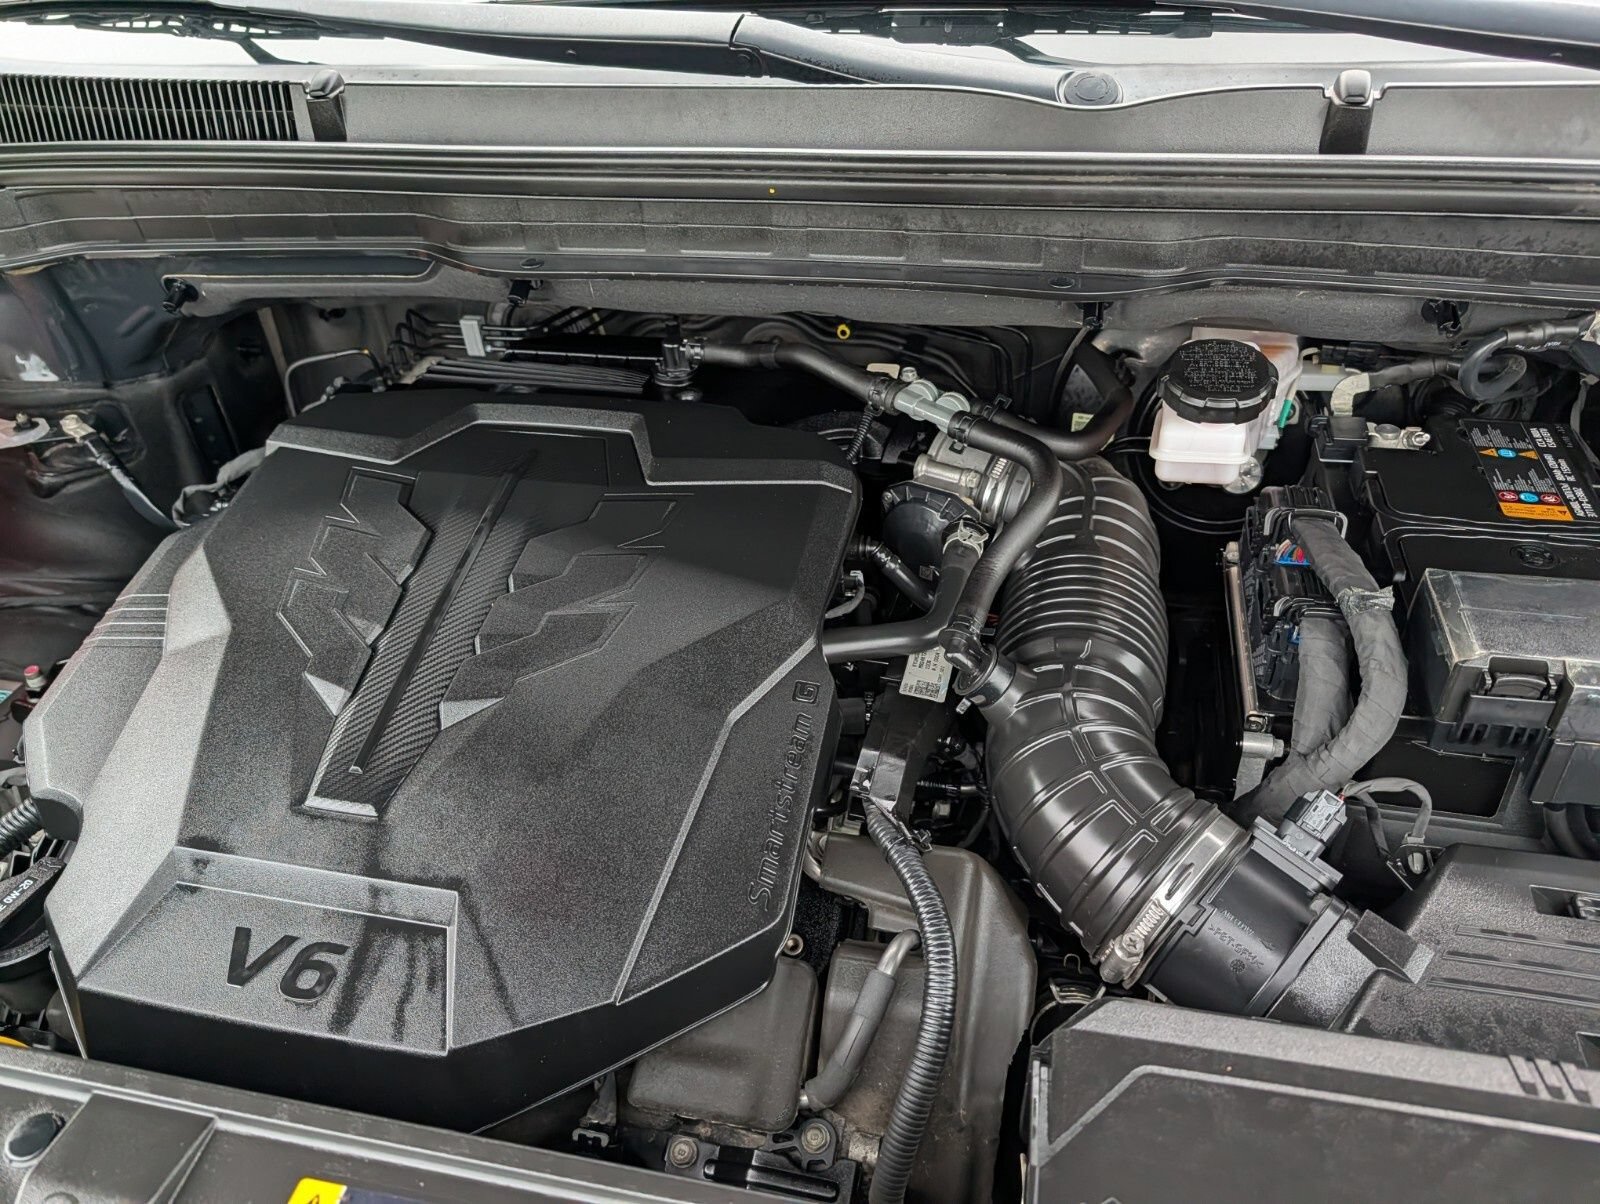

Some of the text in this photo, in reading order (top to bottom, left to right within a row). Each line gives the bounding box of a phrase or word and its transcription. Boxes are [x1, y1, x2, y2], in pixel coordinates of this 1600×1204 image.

[748, 712, 813, 912] Smartstream
[3, 879, 34, 904] 0W-20
[226, 926, 349, 1001] V6
